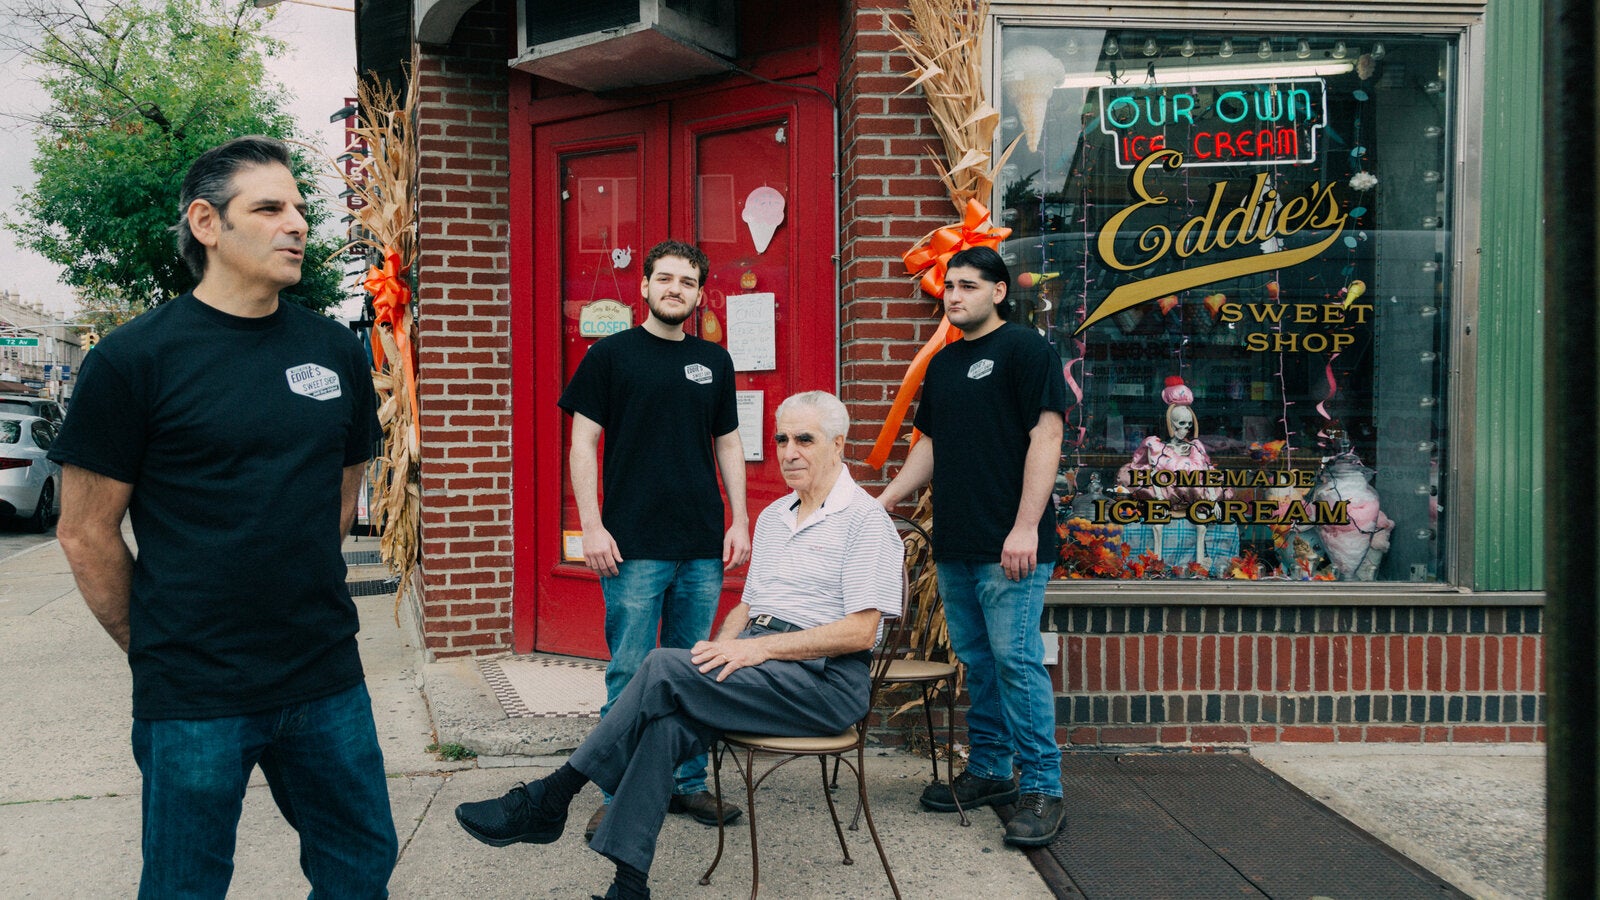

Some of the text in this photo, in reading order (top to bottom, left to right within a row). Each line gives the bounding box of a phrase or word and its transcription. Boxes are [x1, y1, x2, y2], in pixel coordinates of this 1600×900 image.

[1107, 89, 1312, 129] OUR OWN
[1122, 128, 1298, 162] ICE CREAM
[1096, 148, 1342, 271] Eddie's
[1220, 303, 1374, 324] SWEET
[582, 321, 629, 334] CLOSED
[1246, 332, 1355, 353] SHOP
[291, 366, 321, 384] EDDIE'S
[302, 379, 323, 392] SWEET
[323, 375, 337, 386] SHOP
[1128, 469, 1316, 488] HOMEMADE
[1091, 499, 1352, 525] ICE CREAM
